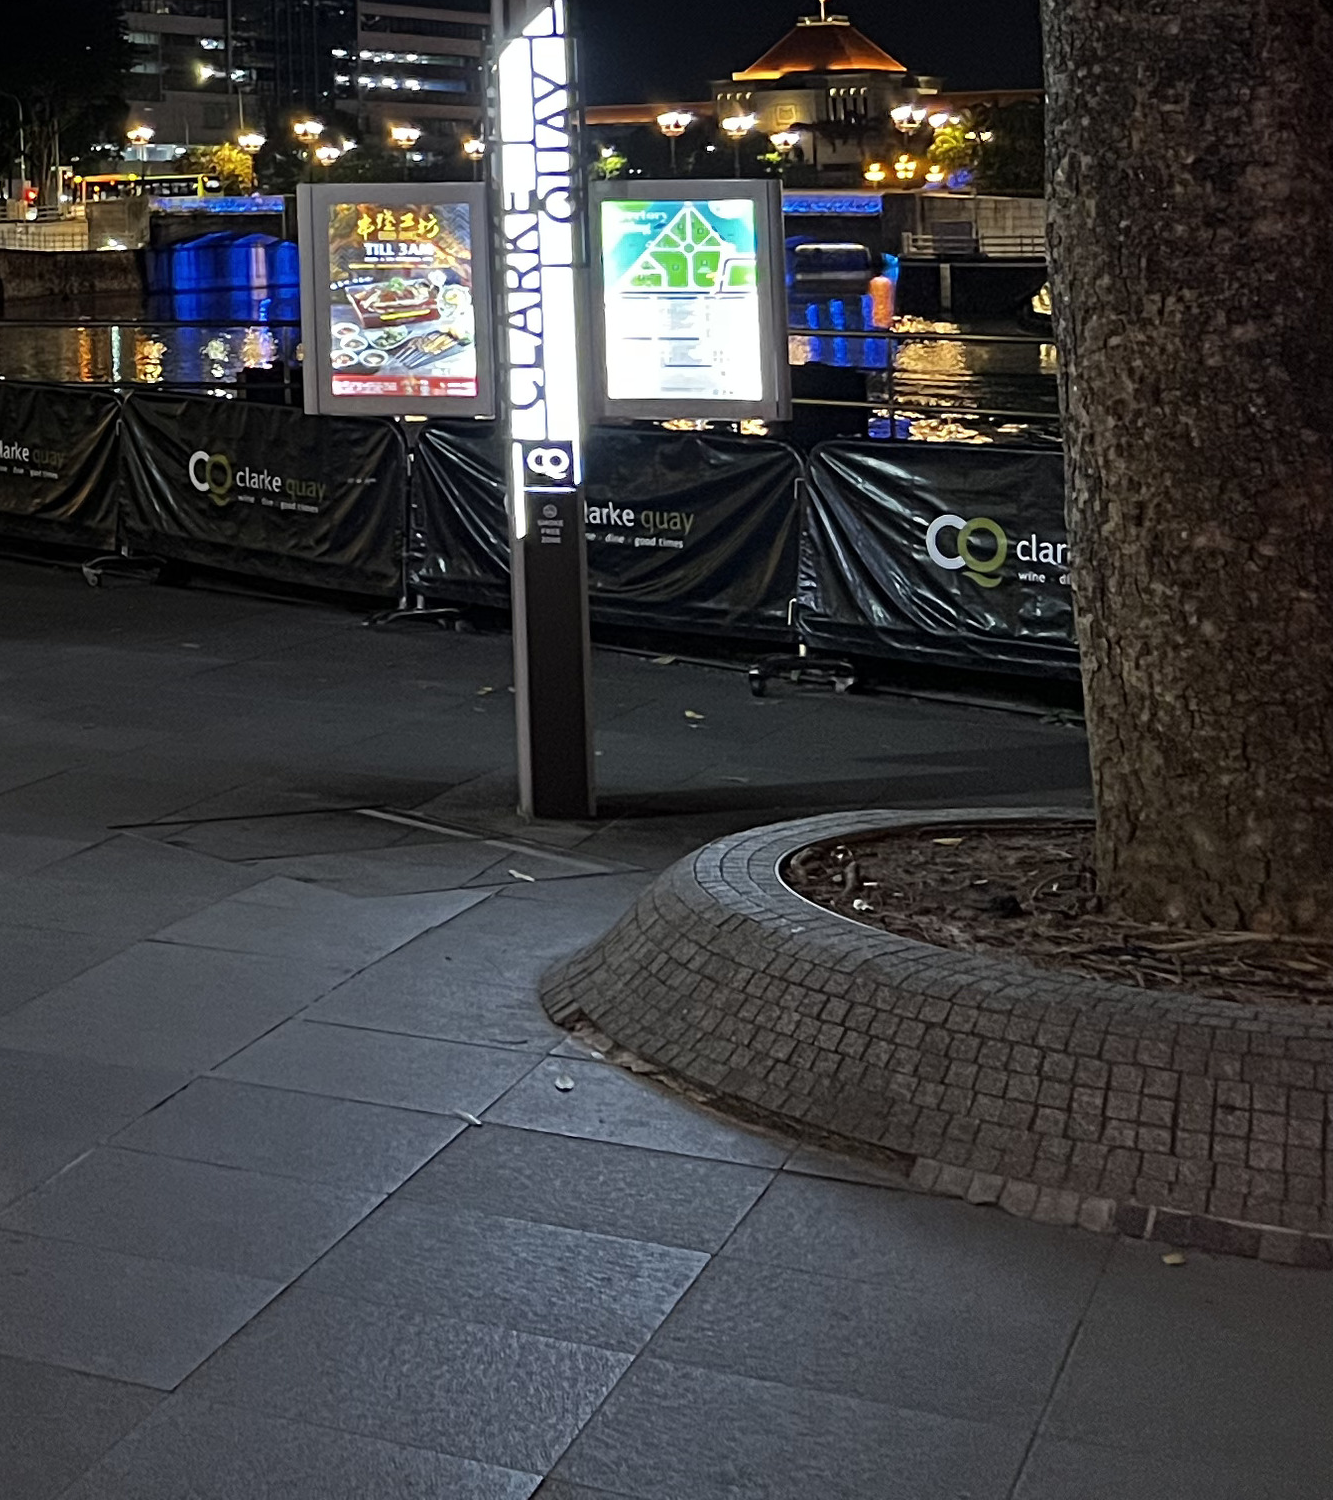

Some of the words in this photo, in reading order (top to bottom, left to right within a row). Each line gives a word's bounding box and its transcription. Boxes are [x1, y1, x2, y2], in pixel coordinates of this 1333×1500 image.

[533, 71, 579, 223] QUAY
[363, 243, 395, 256] TILL
[501, 190, 546, 411] CLARKE
[236, 467, 282, 493] clarke
[286, 478, 326, 502] quay
[583, 500, 635, 527] larke
[641, 510, 695, 536] quay
[1016, 523, 1068, 564] clar
[1018, 571, 1046, 583] wine
[1059, 573, 1071, 585] di
